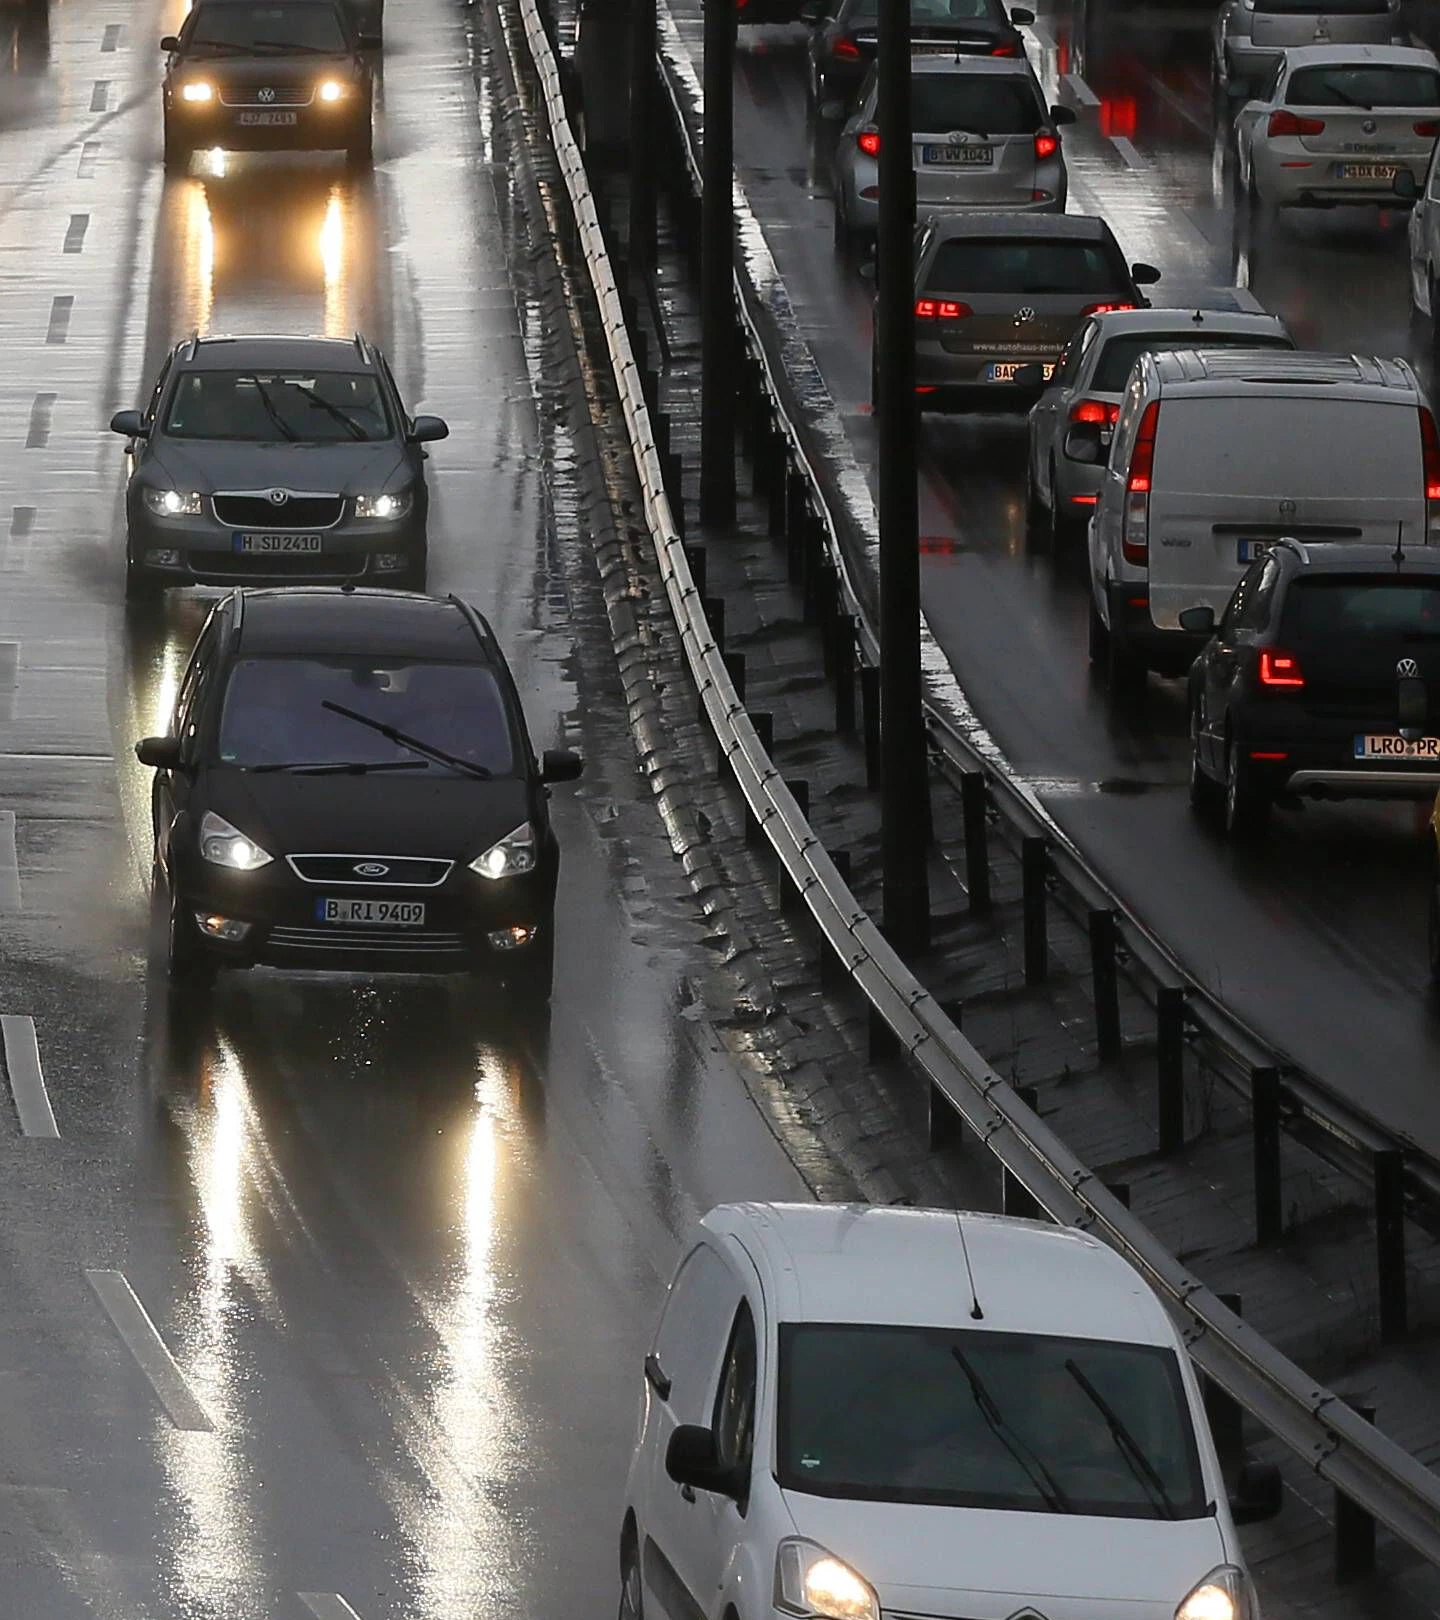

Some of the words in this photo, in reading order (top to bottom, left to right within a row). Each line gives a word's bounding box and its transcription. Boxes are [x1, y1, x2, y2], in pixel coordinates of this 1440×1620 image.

[242, 536, 252, 548] H
[262, 536, 280, 550] SD
[283, 537, 319, 551] 2410
[1371, 738, 1404, 754] LRO
[1419, 738, 1439, 755] PR
[327, 900, 338, 918] B
[350, 901, 372, 920] RI
[379, 903, 423, 922] 9409
